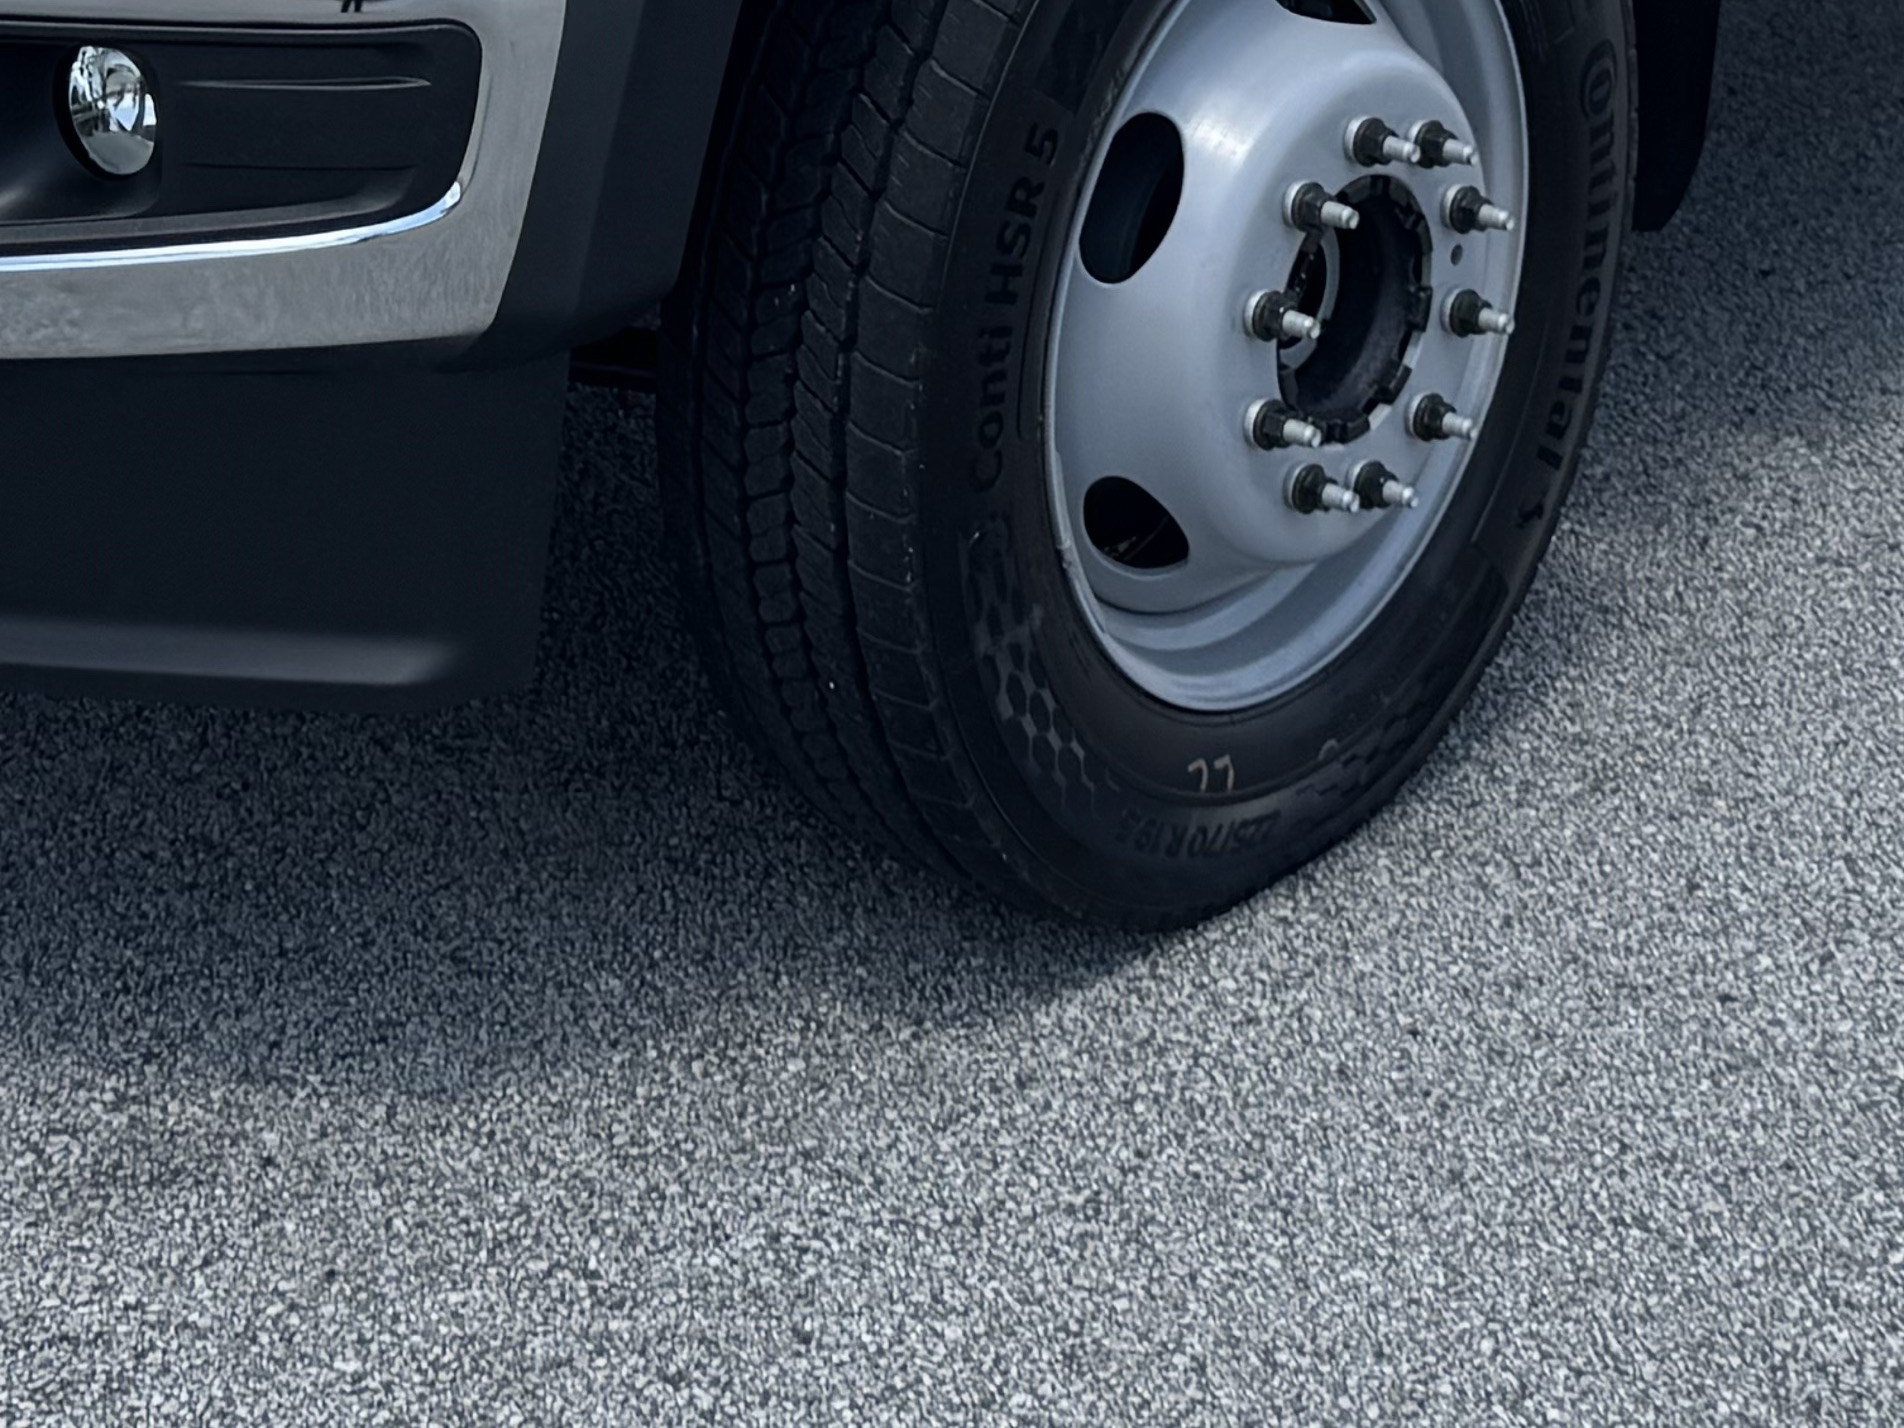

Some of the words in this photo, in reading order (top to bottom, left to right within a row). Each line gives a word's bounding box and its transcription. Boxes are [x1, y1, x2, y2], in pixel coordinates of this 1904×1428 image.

[1023, 123, 1061, 167] 5
[984, 176, 1047, 307] HSR
[1536, 38, 1619, 471] Continental
[970, 325, 1014, 491] Conti
